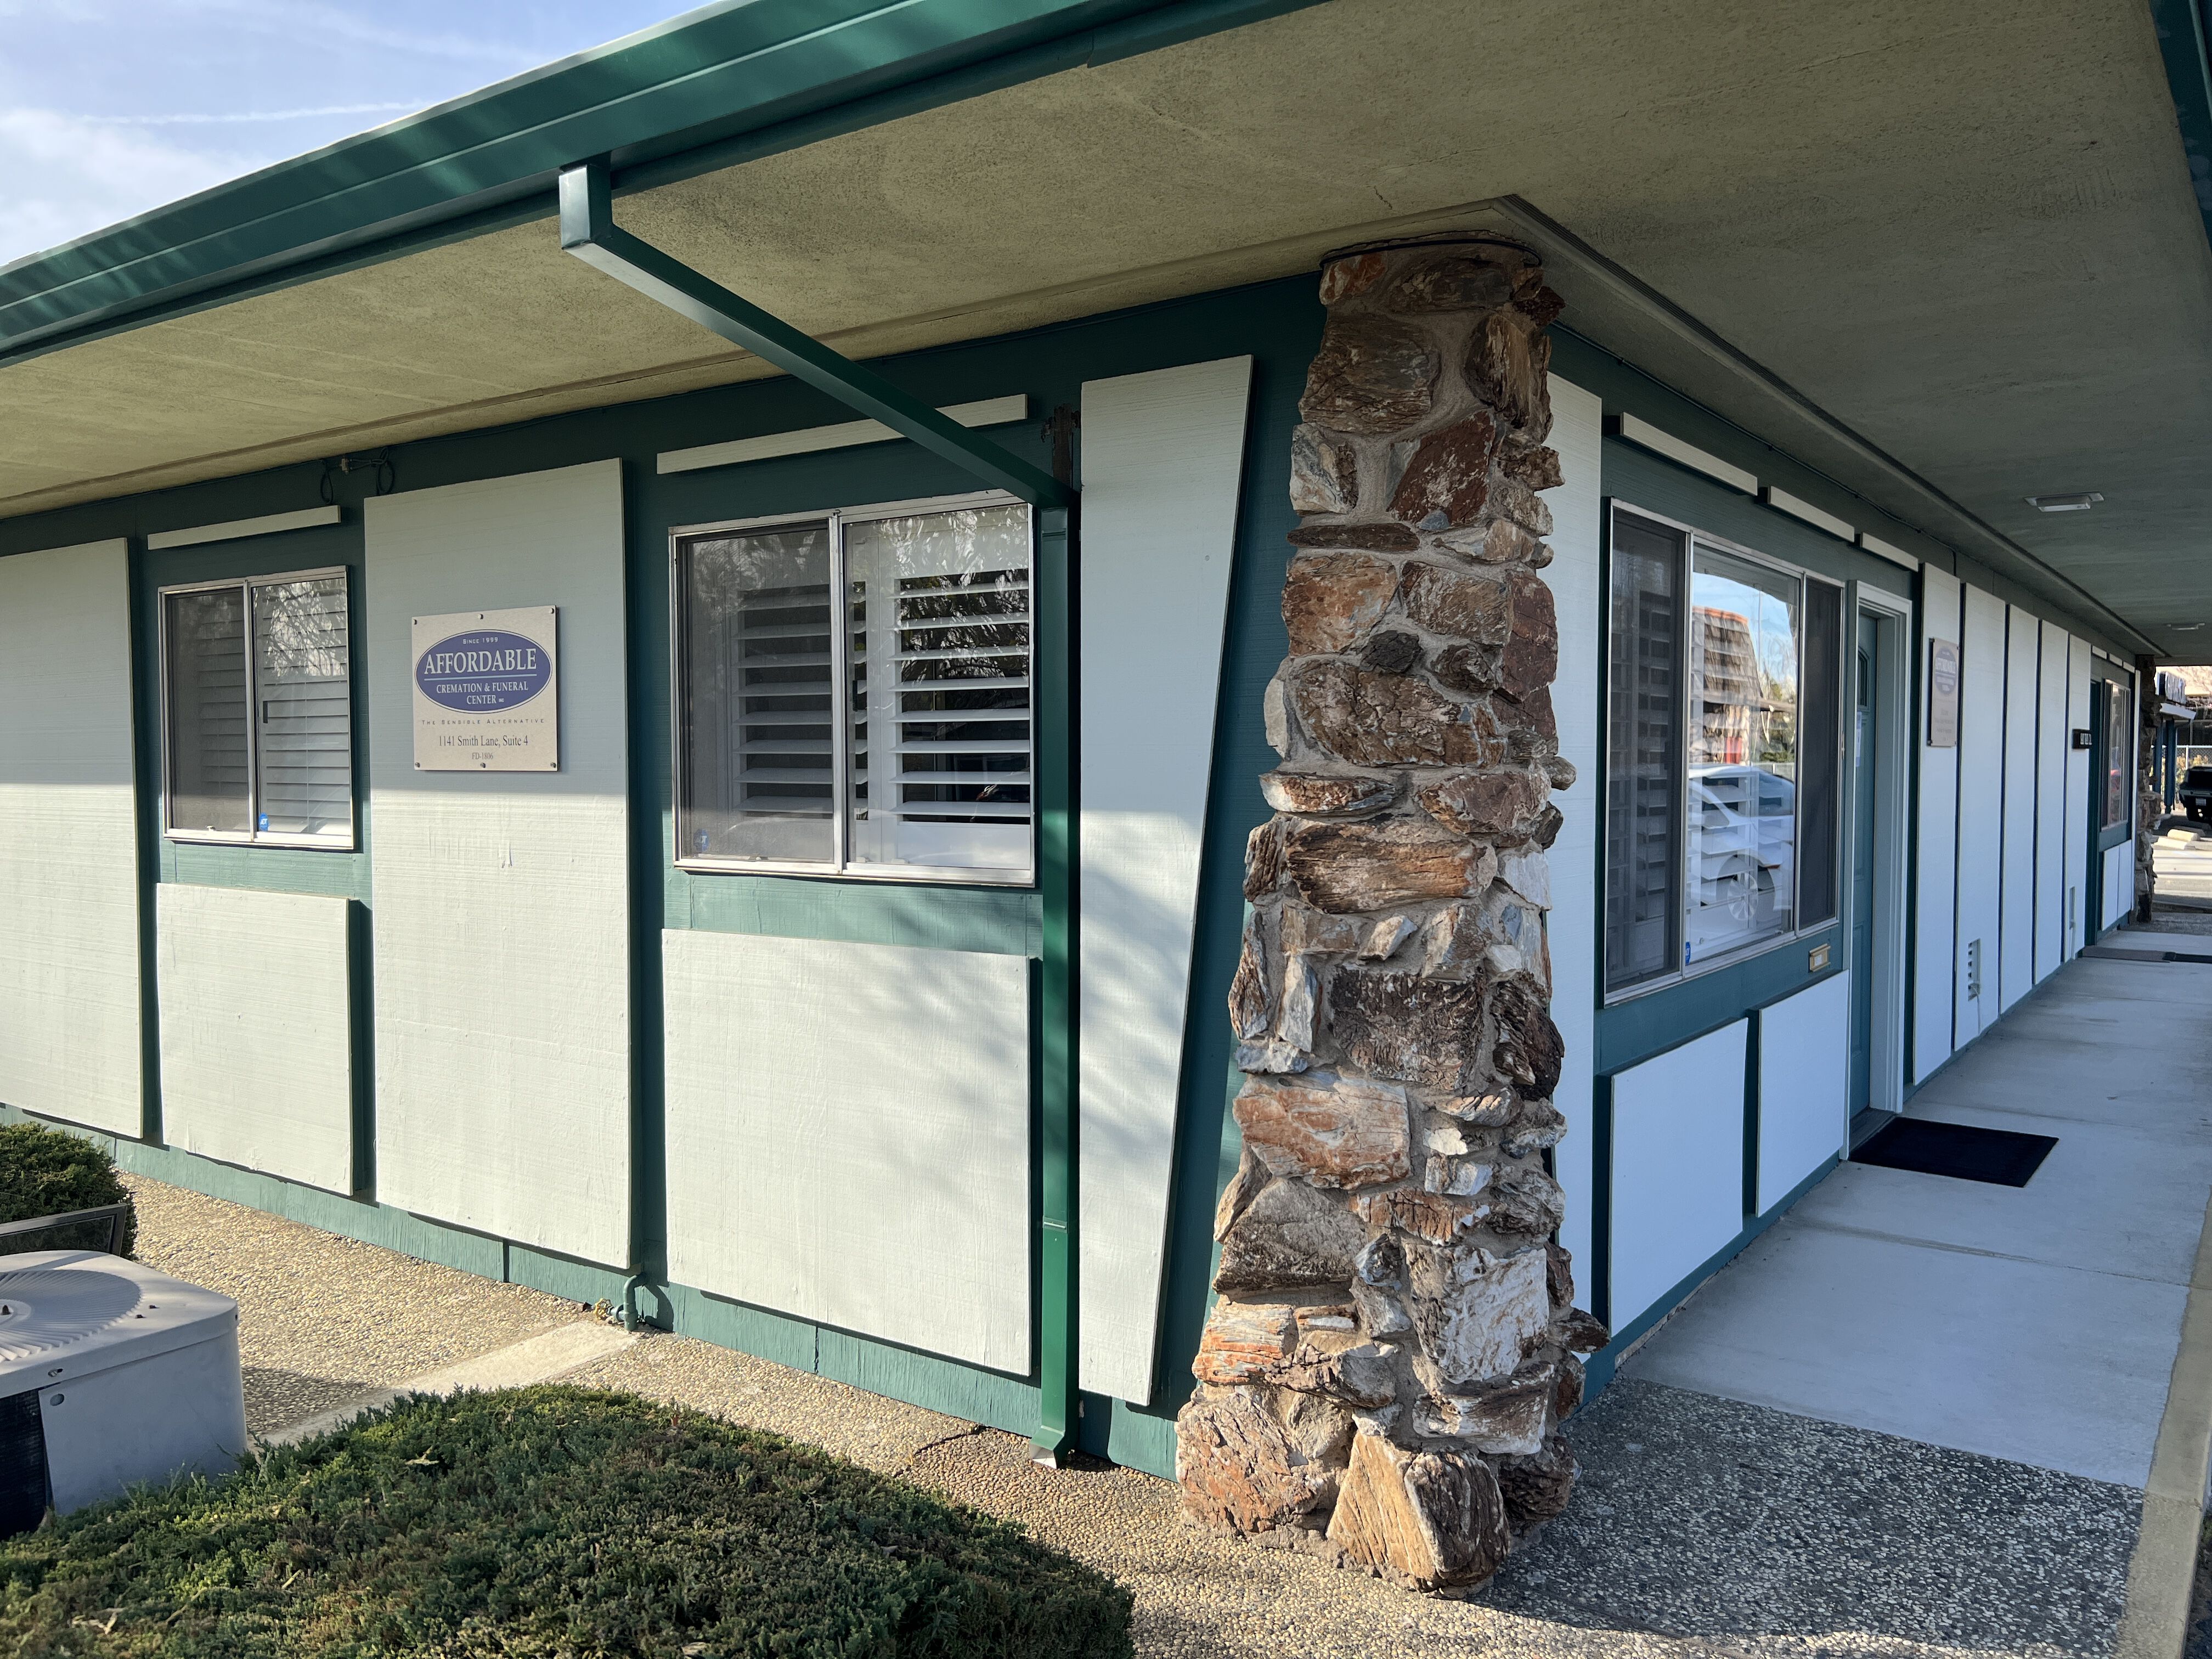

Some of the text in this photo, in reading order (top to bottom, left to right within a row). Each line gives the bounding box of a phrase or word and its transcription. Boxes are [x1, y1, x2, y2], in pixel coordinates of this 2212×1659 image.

[424, 648, 537, 674] AFFORDABLE
[436, 681, 529, 693] CREMATION & FUNERAL
[466, 695, 496, 705] CENTER
[439, 735, 528, 748] 1141 Smith Lane, Suite 4
[472, 752, 494, 760] FD-1806
